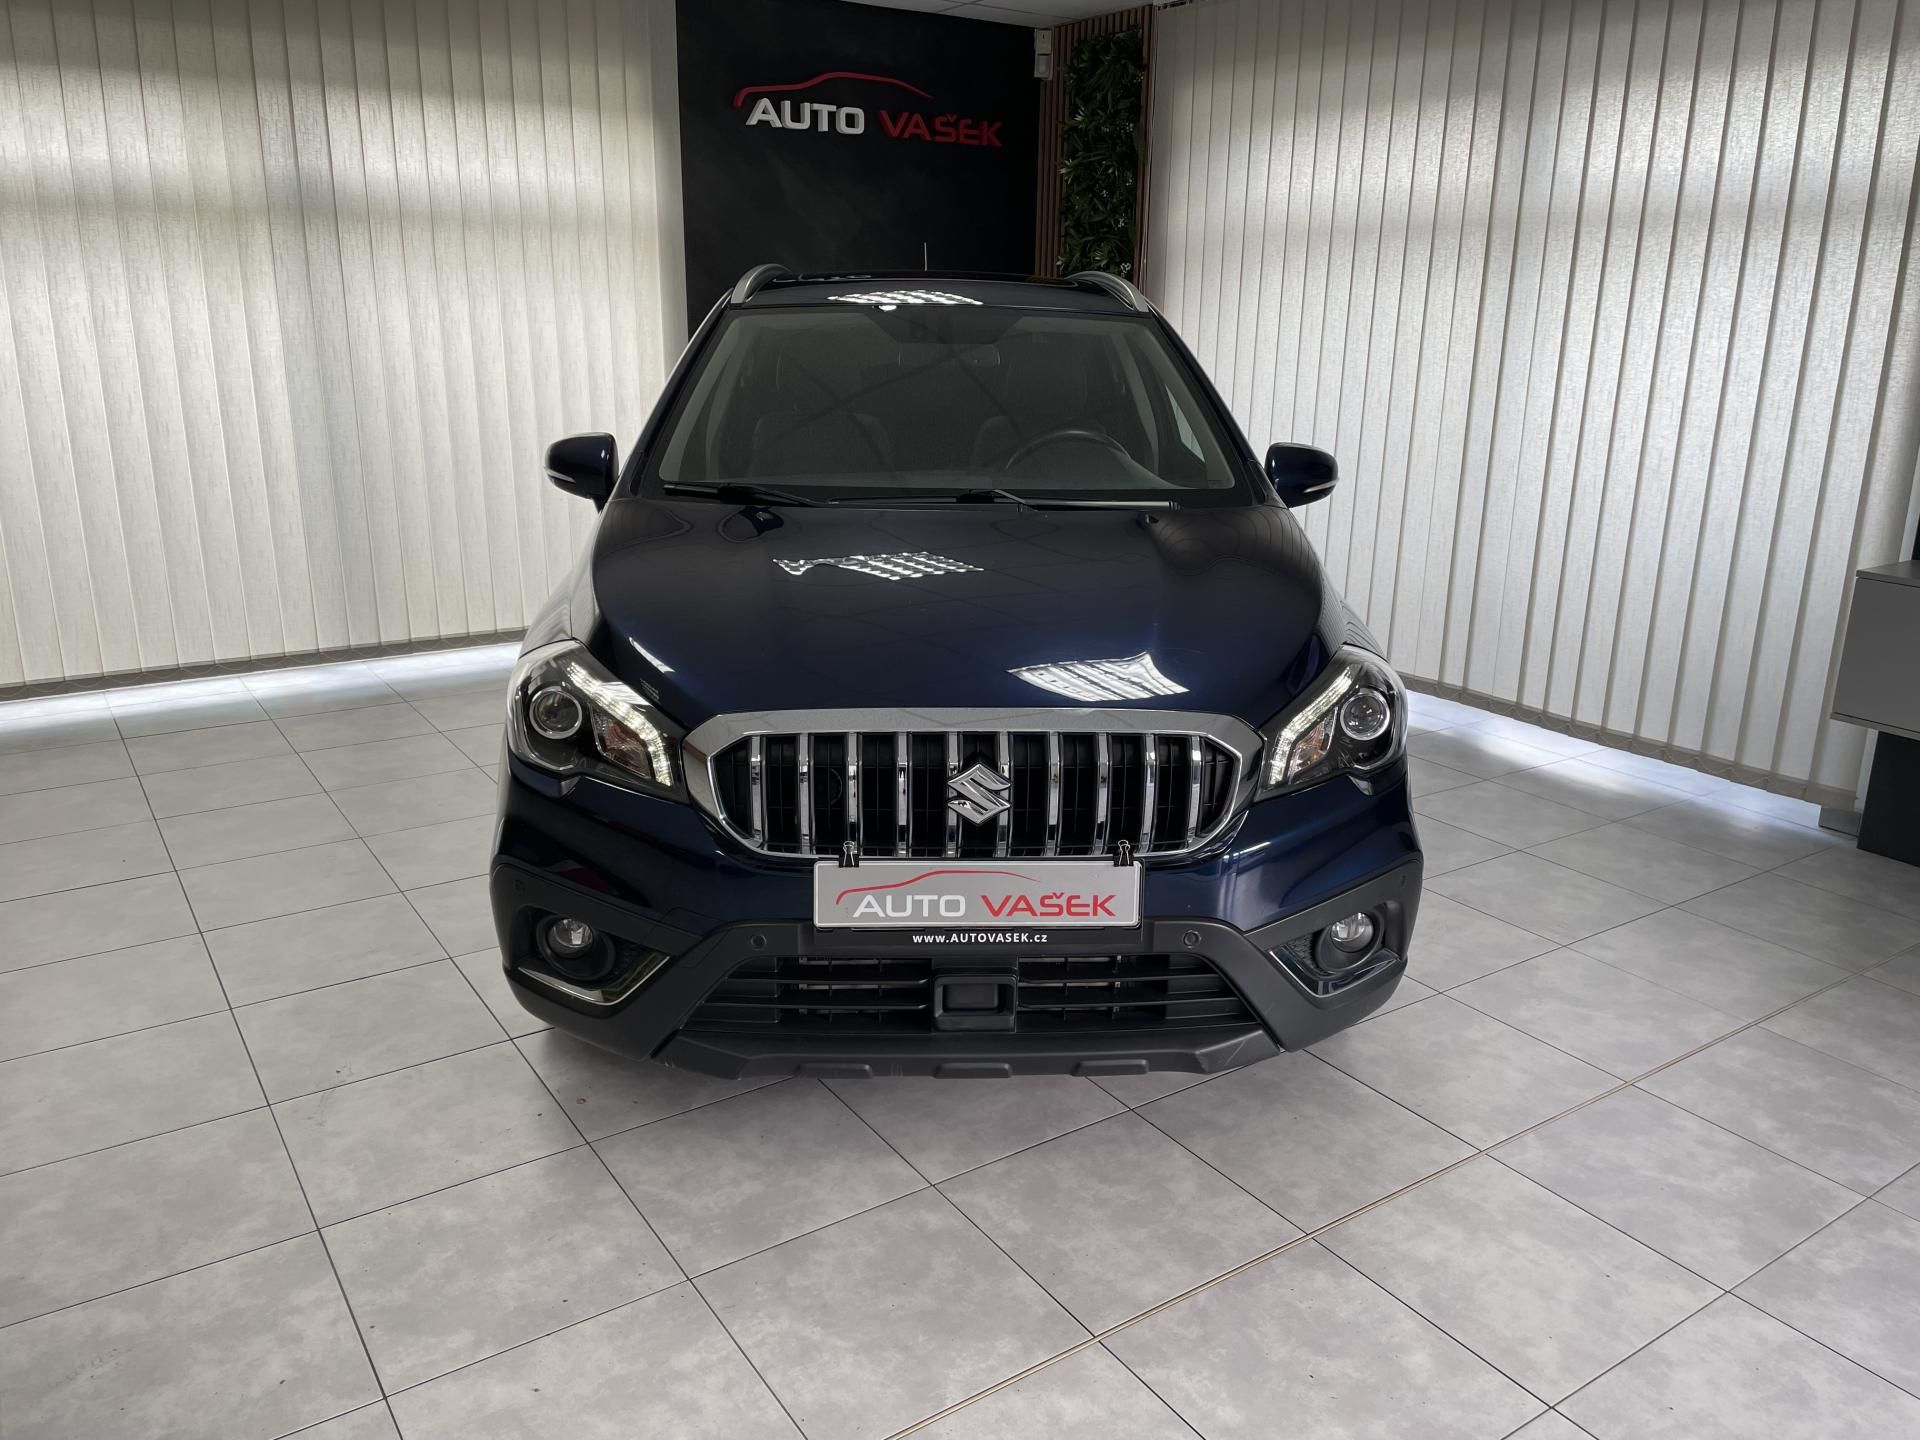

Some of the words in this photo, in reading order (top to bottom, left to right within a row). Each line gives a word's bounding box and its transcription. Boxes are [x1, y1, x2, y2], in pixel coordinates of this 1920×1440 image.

[746, 97, 865, 135] AUTO
[879, 109, 1002, 147] VAŠEK
[852, 894, 965, 918] AUTO
[980, 892, 1117, 917] VAŠEK
